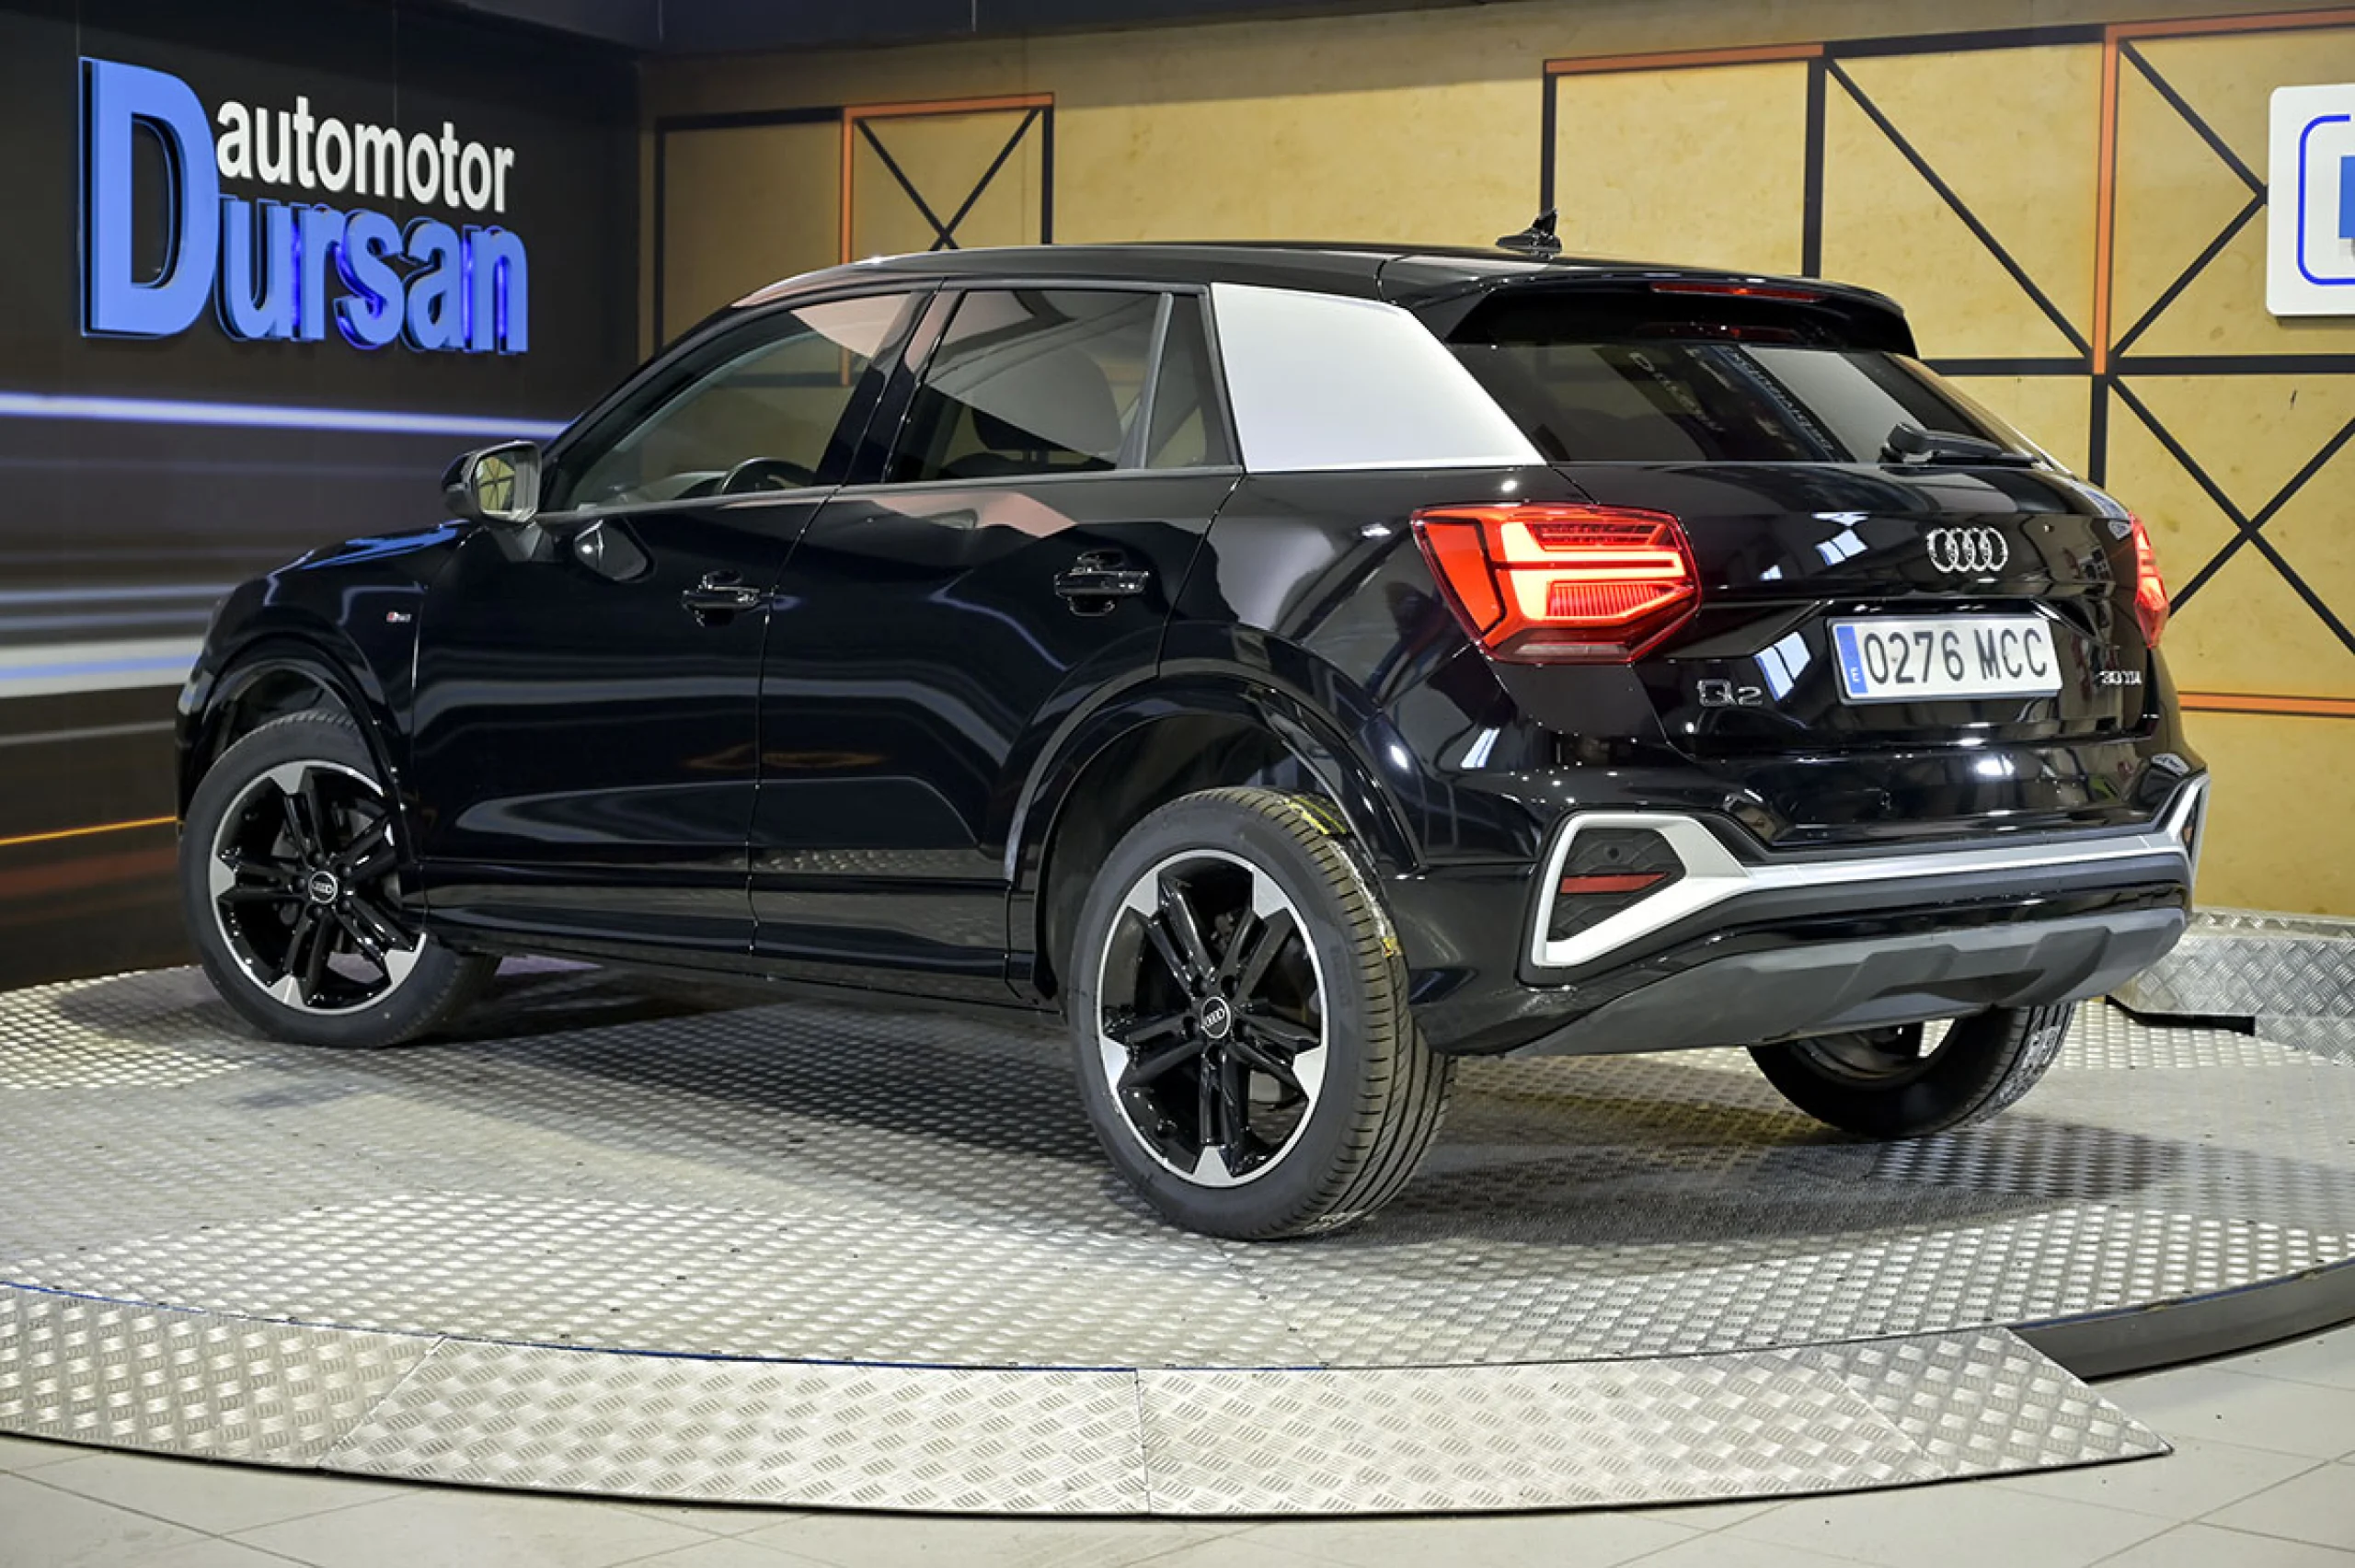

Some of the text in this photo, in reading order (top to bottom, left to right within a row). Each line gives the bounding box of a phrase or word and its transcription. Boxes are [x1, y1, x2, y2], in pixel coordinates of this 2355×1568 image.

[216, 96, 514, 212] automotor
[79, 56, 528, 355] Dursan
[1696, 679, 1763, 706] Q2
[1864, 628, 2048, 684] 0276 MCC
